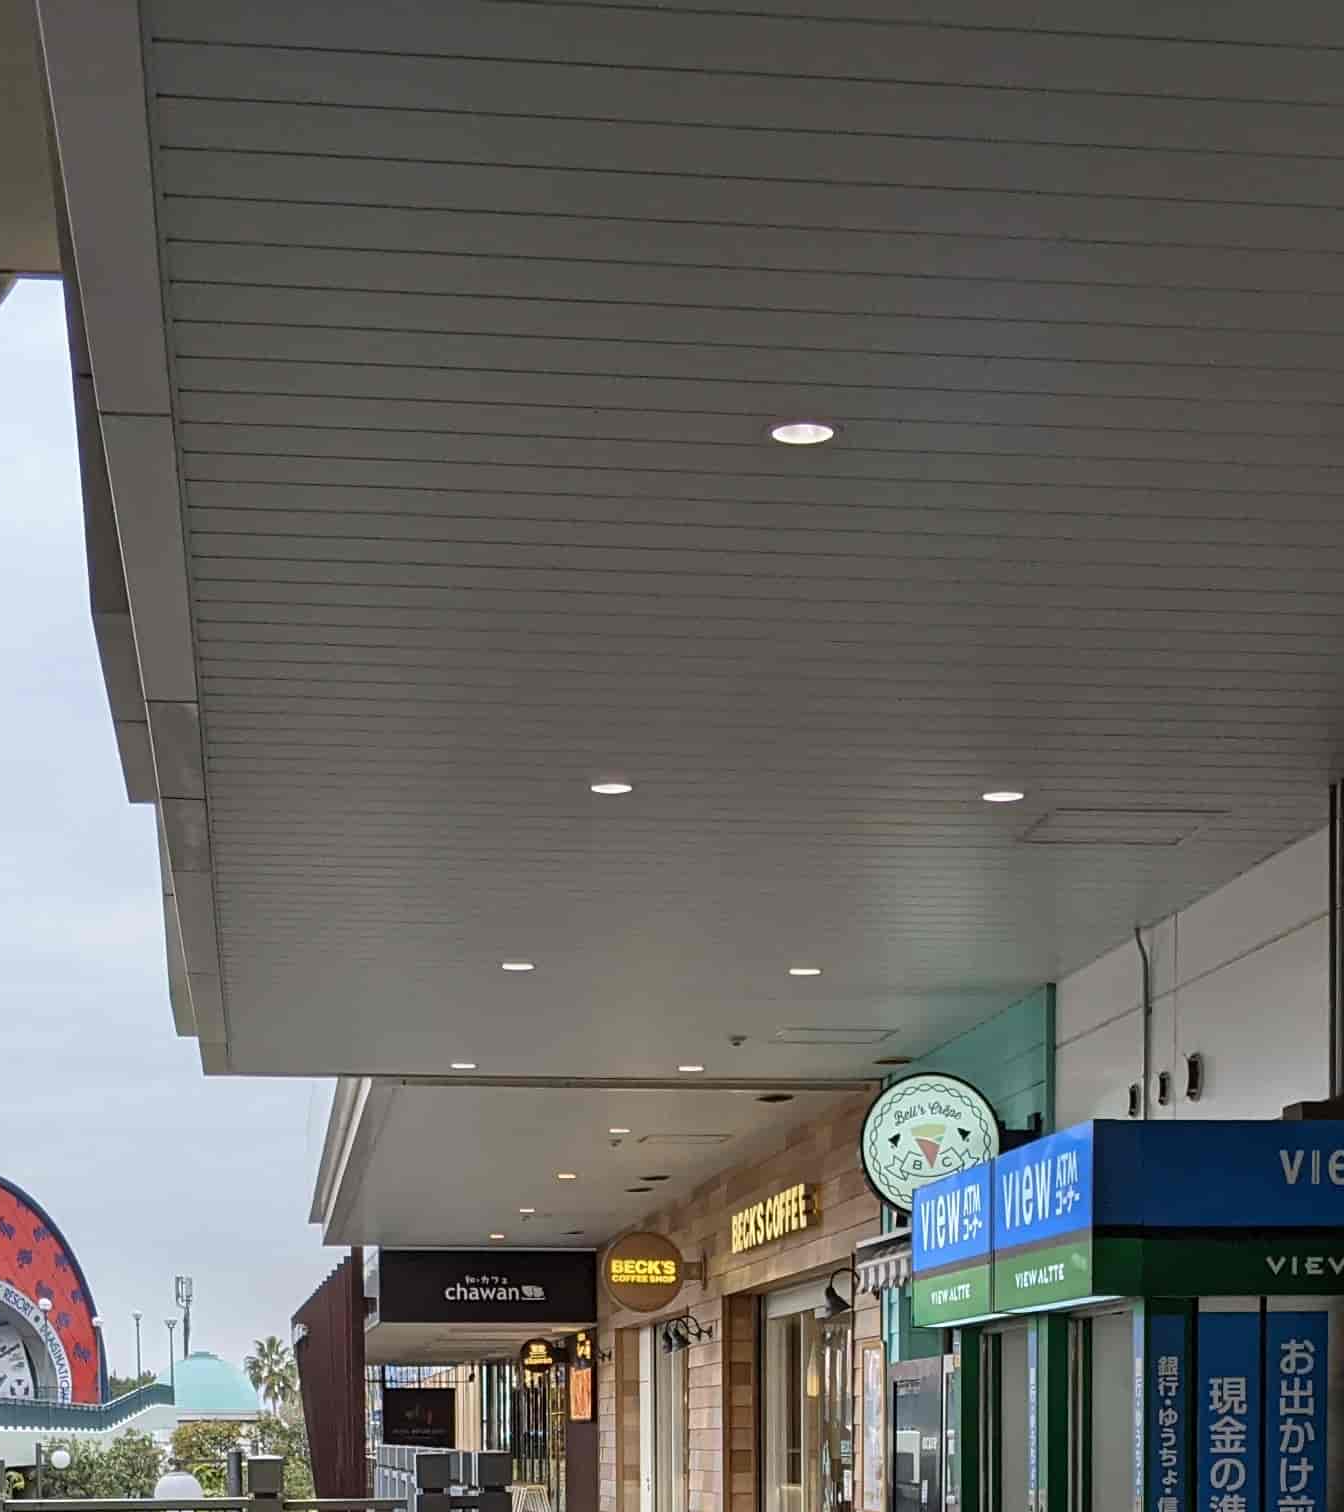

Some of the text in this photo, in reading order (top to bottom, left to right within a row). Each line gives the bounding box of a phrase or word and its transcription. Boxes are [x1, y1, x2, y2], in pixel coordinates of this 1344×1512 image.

[912, 1156, 953, 1171] B C
[1055, 1151, 1078, 1187] ATM
[765, 1184, 807, 1241] COFFEE
[962, 1184, 982, 1217] ATM
[611, 1259, 676, 1274] BECK'S
[611, 1273, 677, 1284] COFFEE SHOP
[1014, 1263, 1065, 1289] VIEW ALTTE
[4, 1287, 35, 1317] RESORT
[444, 1282, 520, 1301] chawan
[930, 1283, 971, 1305] VIEW ALTTE
